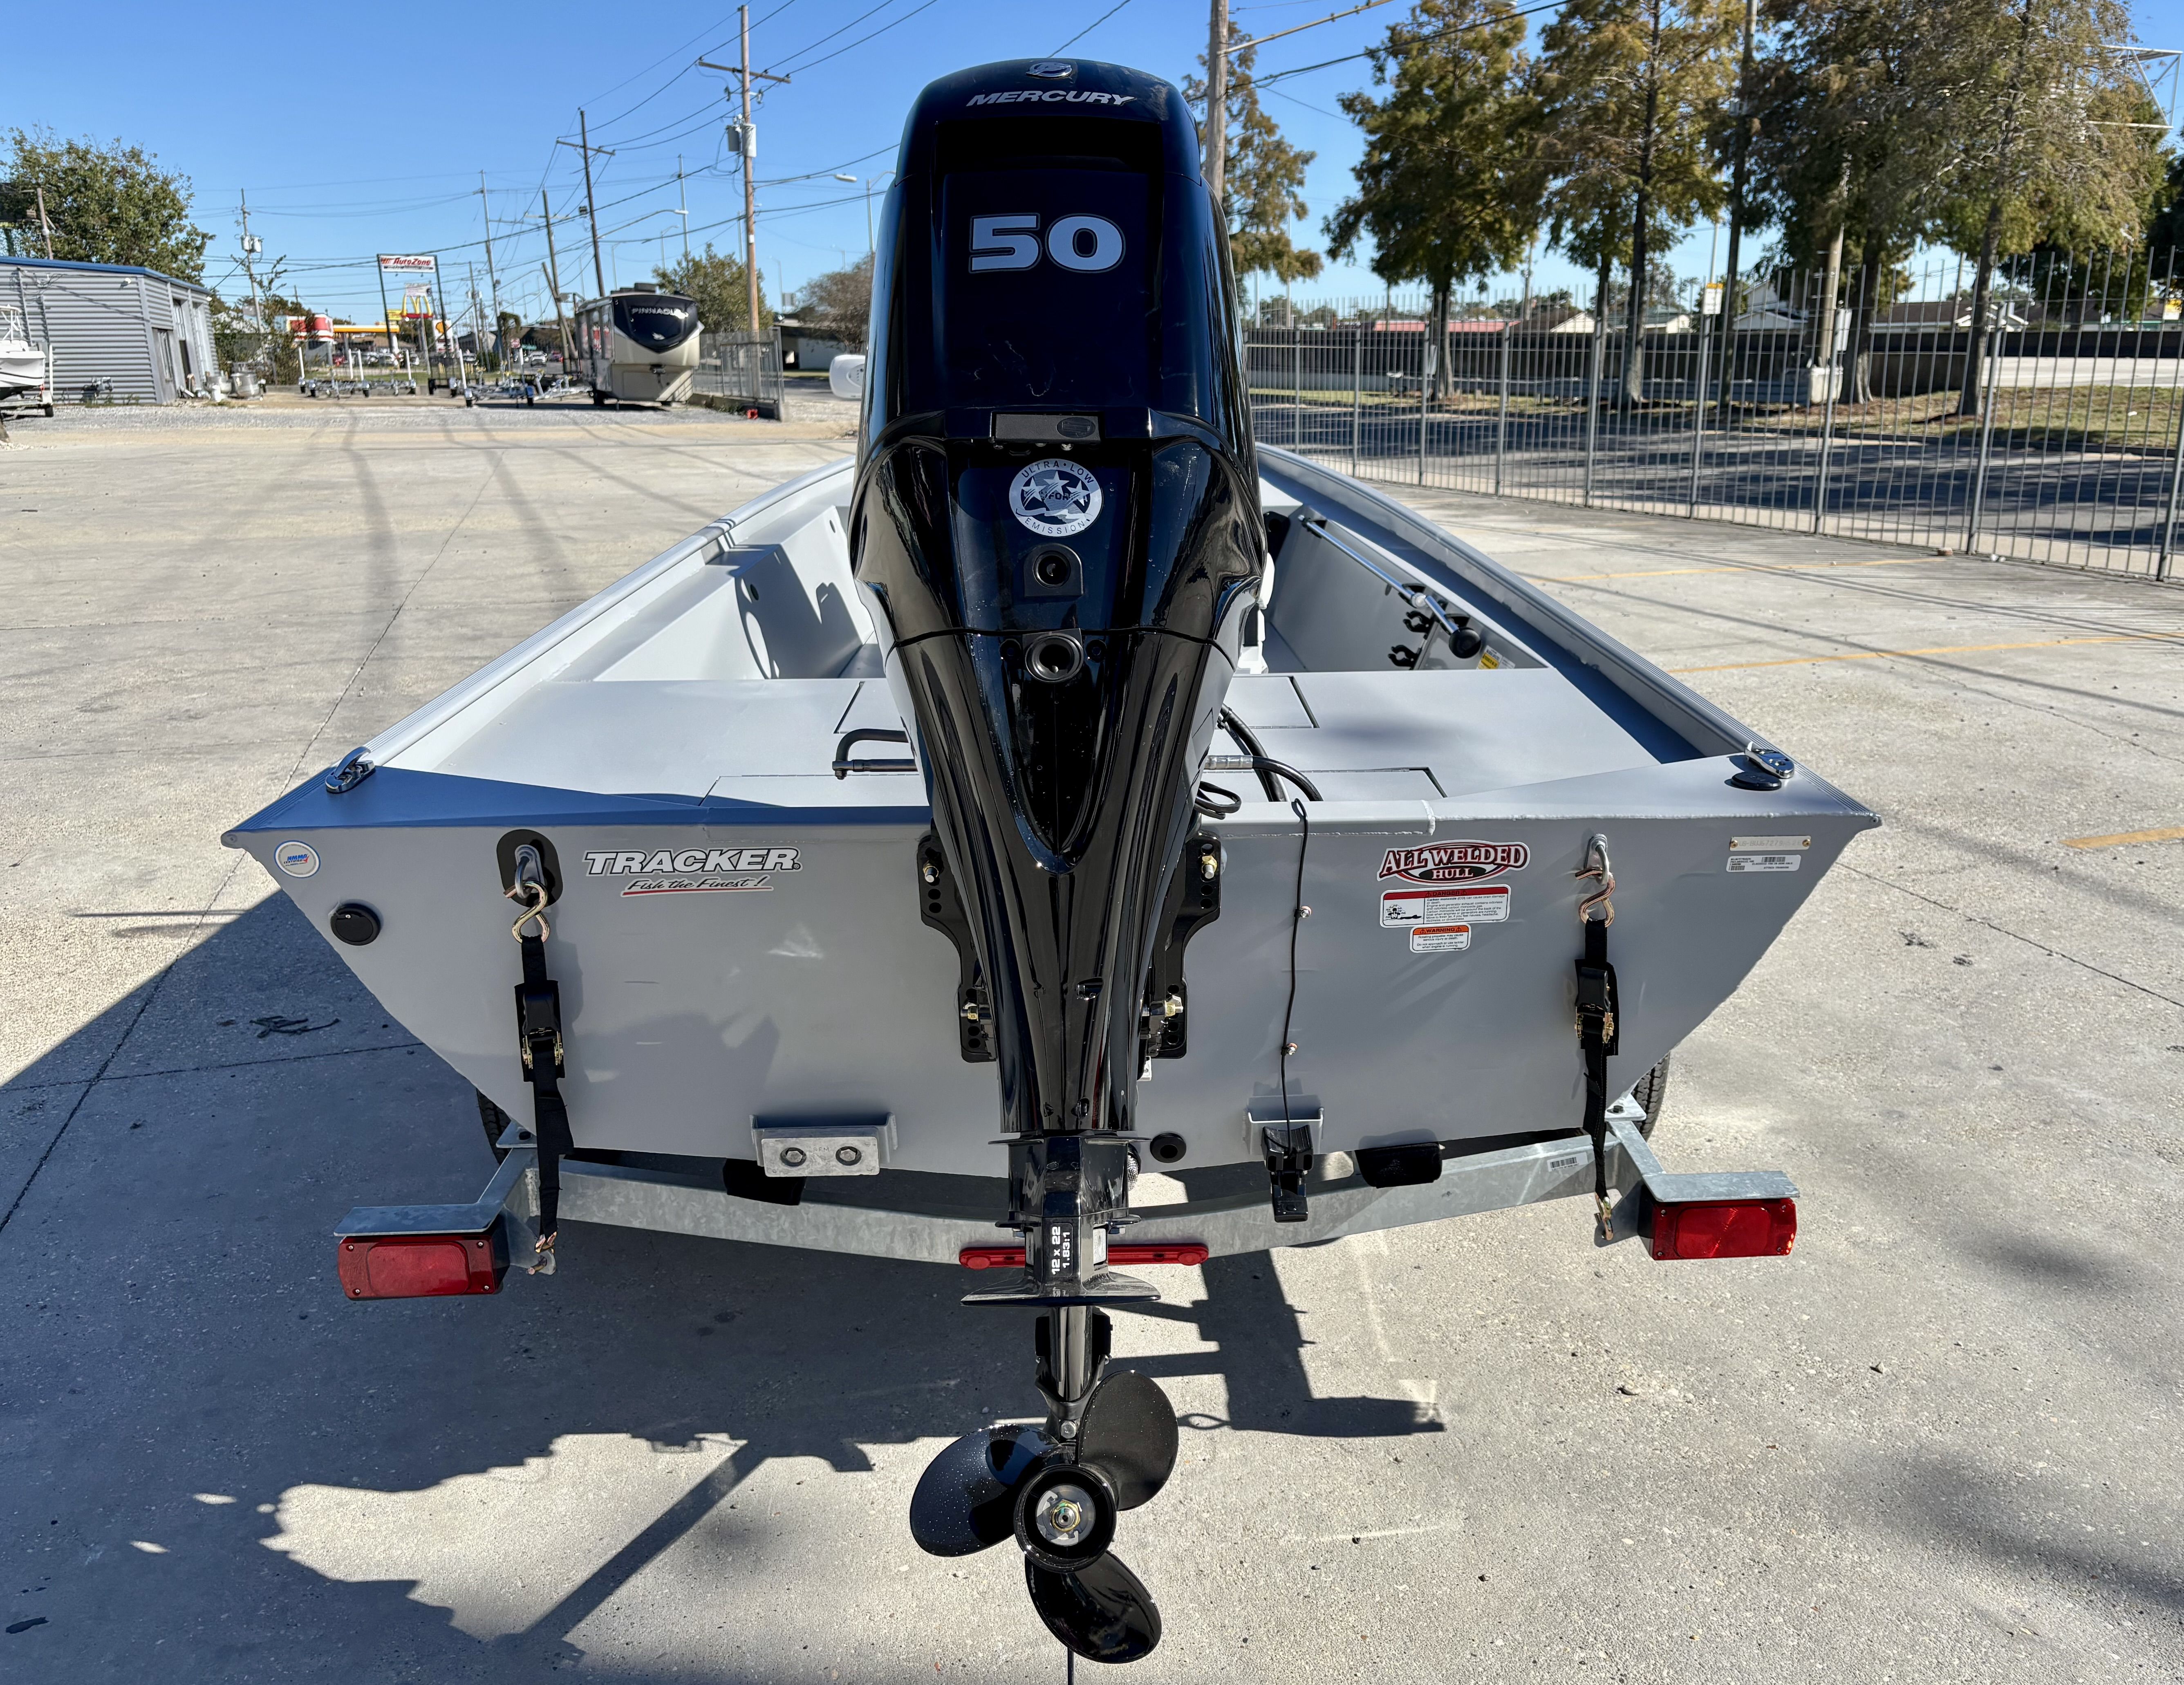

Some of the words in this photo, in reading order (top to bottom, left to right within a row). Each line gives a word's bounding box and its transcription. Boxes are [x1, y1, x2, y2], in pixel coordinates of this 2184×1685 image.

[966, 90, 1136, 107] MERCURY
[970, 213, 1125, 272] 50
[393, 257, 431, 265] AutoZone
[631, 307, 689, 319] PINNACL
[1021, 460, 1059, 478] ULTRA
[1070, 464, 1094, 484] LOW
[585, 848, 799, 874] TRACKER
[1380, 850, 1428, 877] ALL
[1430, 845, 1528, 868] WELDED
[1431, 868, 1473, 879] HULL
[627, 878, 664, 890] Fish
[668, 878, 695, 889] the
[1052, 1226, 1061, 1245] 22
[1052, 1259, 1060, 1275] 12
